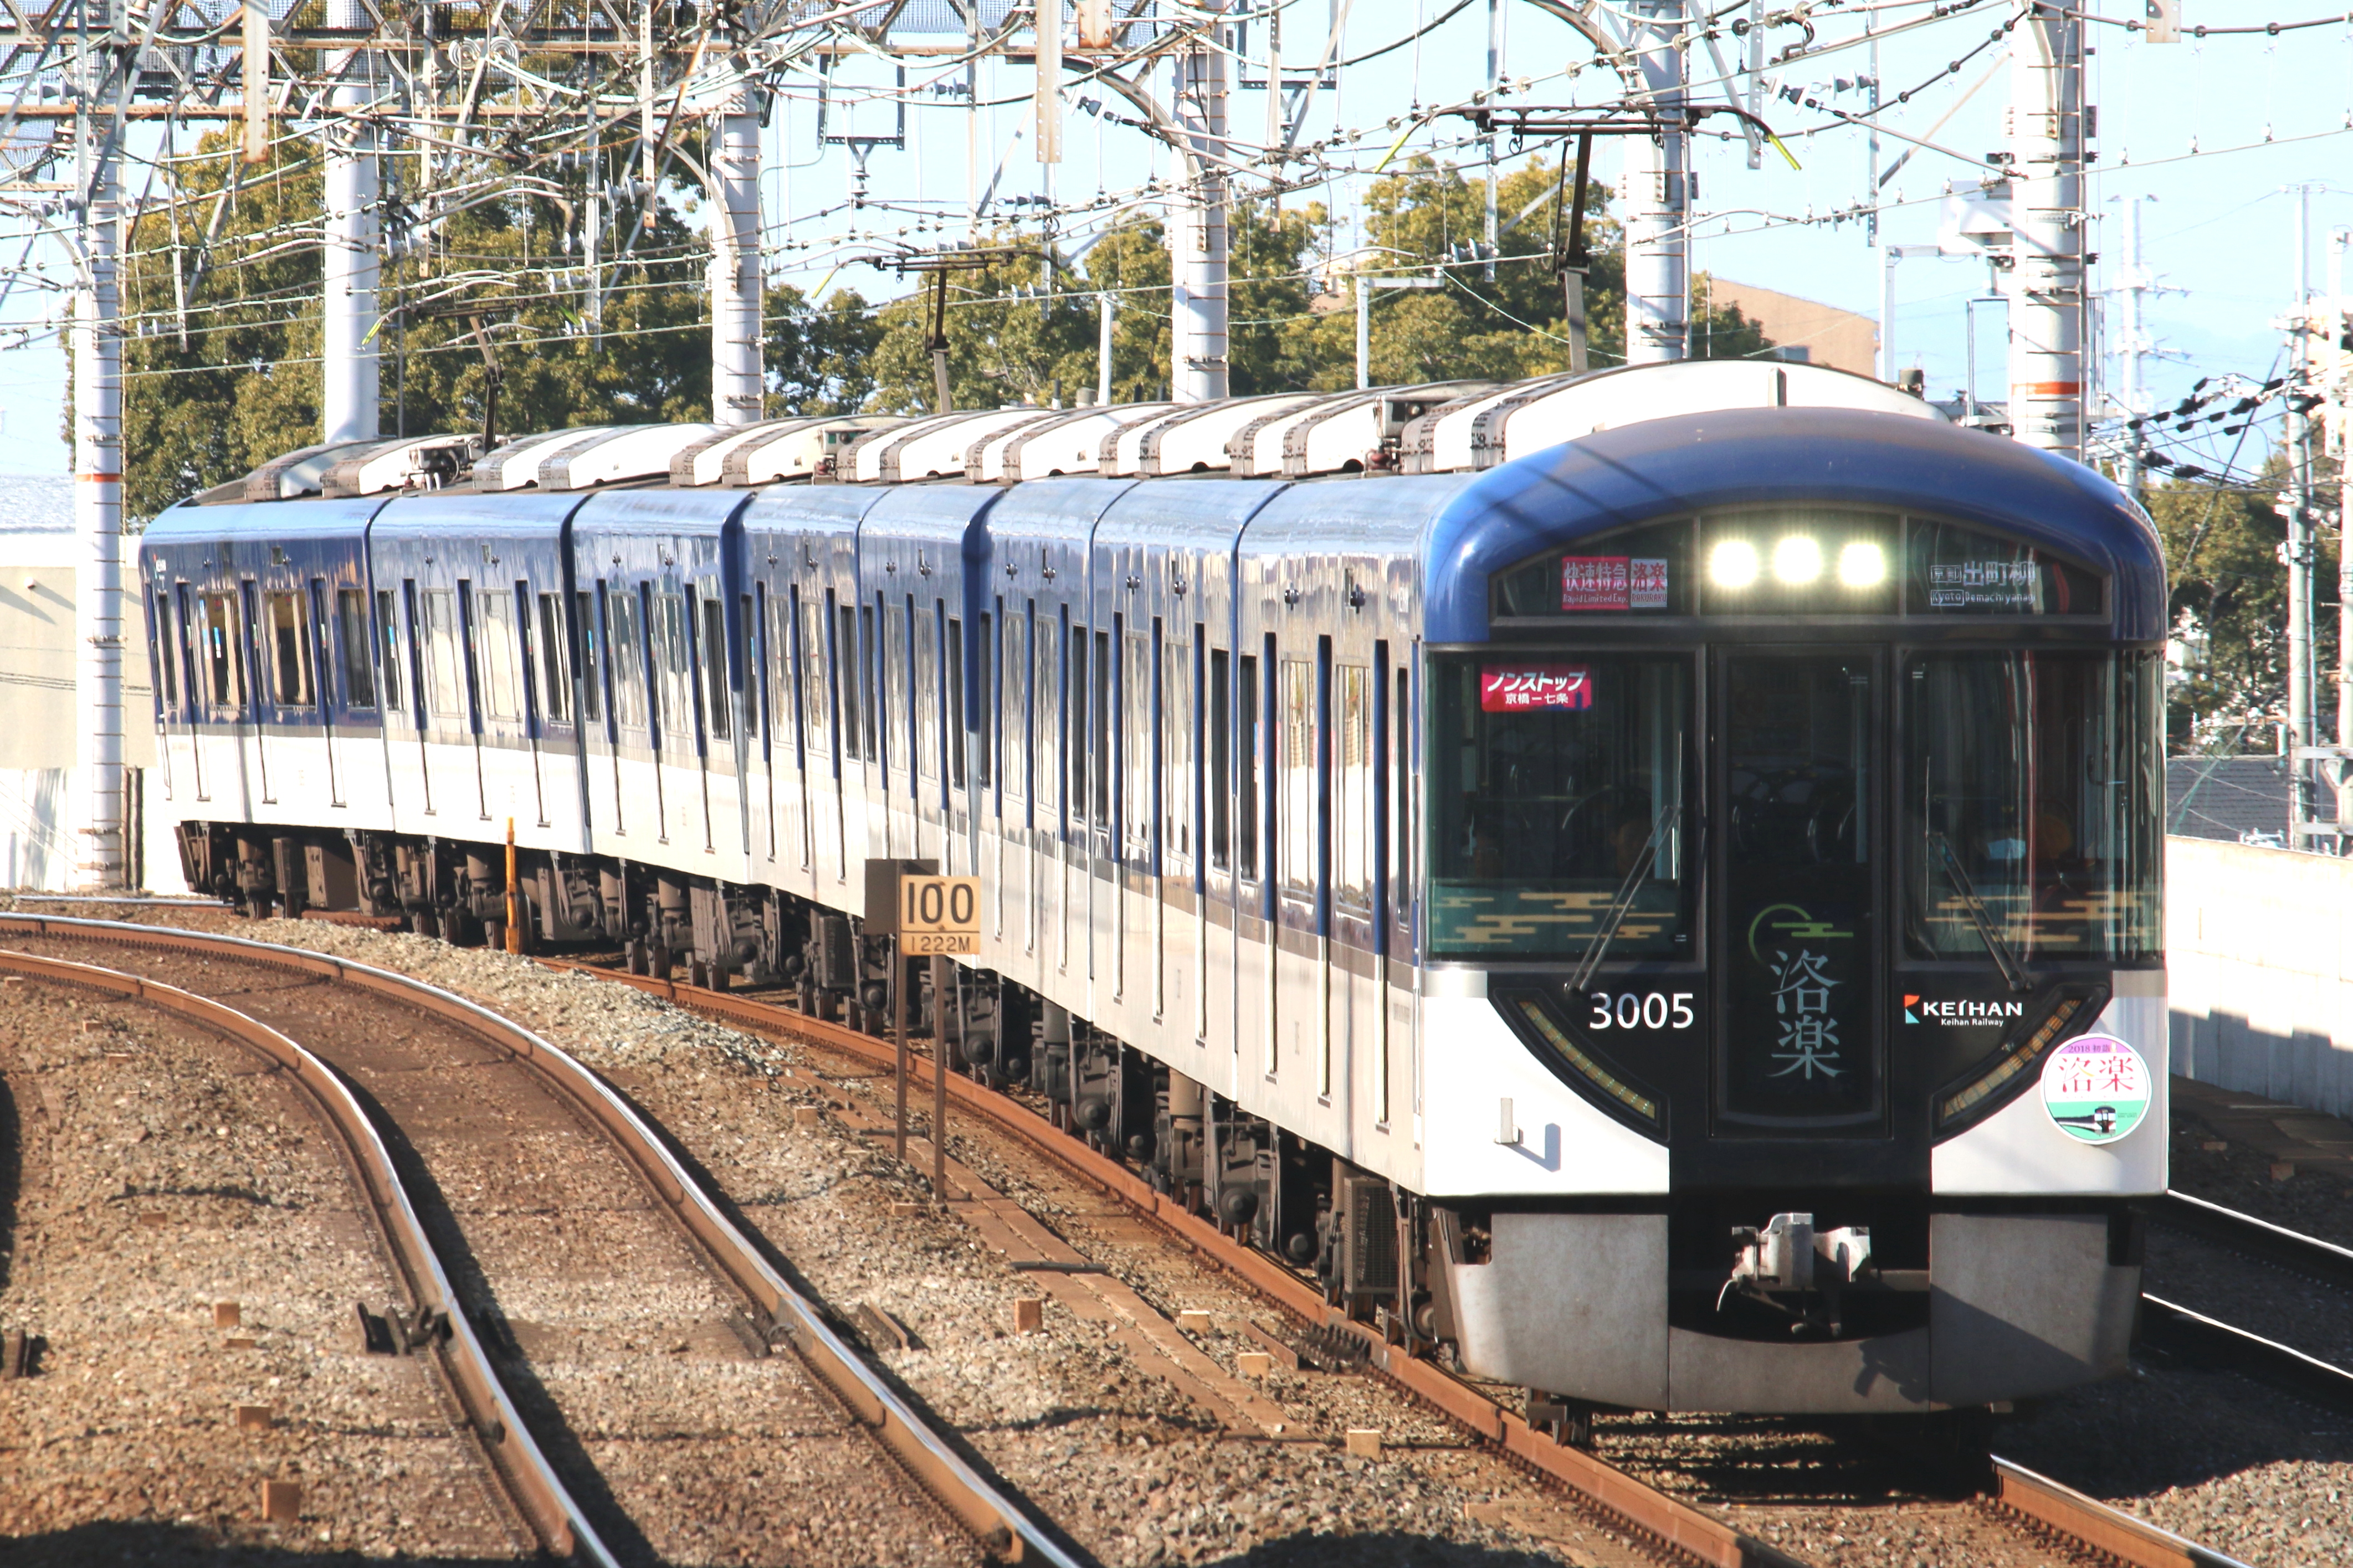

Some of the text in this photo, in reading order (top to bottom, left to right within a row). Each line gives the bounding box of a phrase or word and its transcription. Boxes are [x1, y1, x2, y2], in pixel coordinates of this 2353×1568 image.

[1564, 562, 1666, 592] 快速特急 洛楽
[1964, 561, 2036, 586] 出町柳
[1563, 594, 1628, 604] Rapid Limited Exp.
[1632, 594, 1667, 602] RAKURAKU
[1932, 592, 2036, 605] Kyoto Demachiyanagi
[1487, 671, 1586, 692] ノンストップ
[908, 882, 973, 924] 100
[912, 935, 970, 952] 1222M
[1590, 992, 1694, 1029] 3005
[1766, 949, 1849, 1079] 洛楽
[1923, 1000, 2022, 1016] KEIHAN
[1972, 1017, 2003, 1027] Railway
[2069, 1045, 2090, 1053] 2018
[2058, 1056, 2134, 1093] 洛楽
